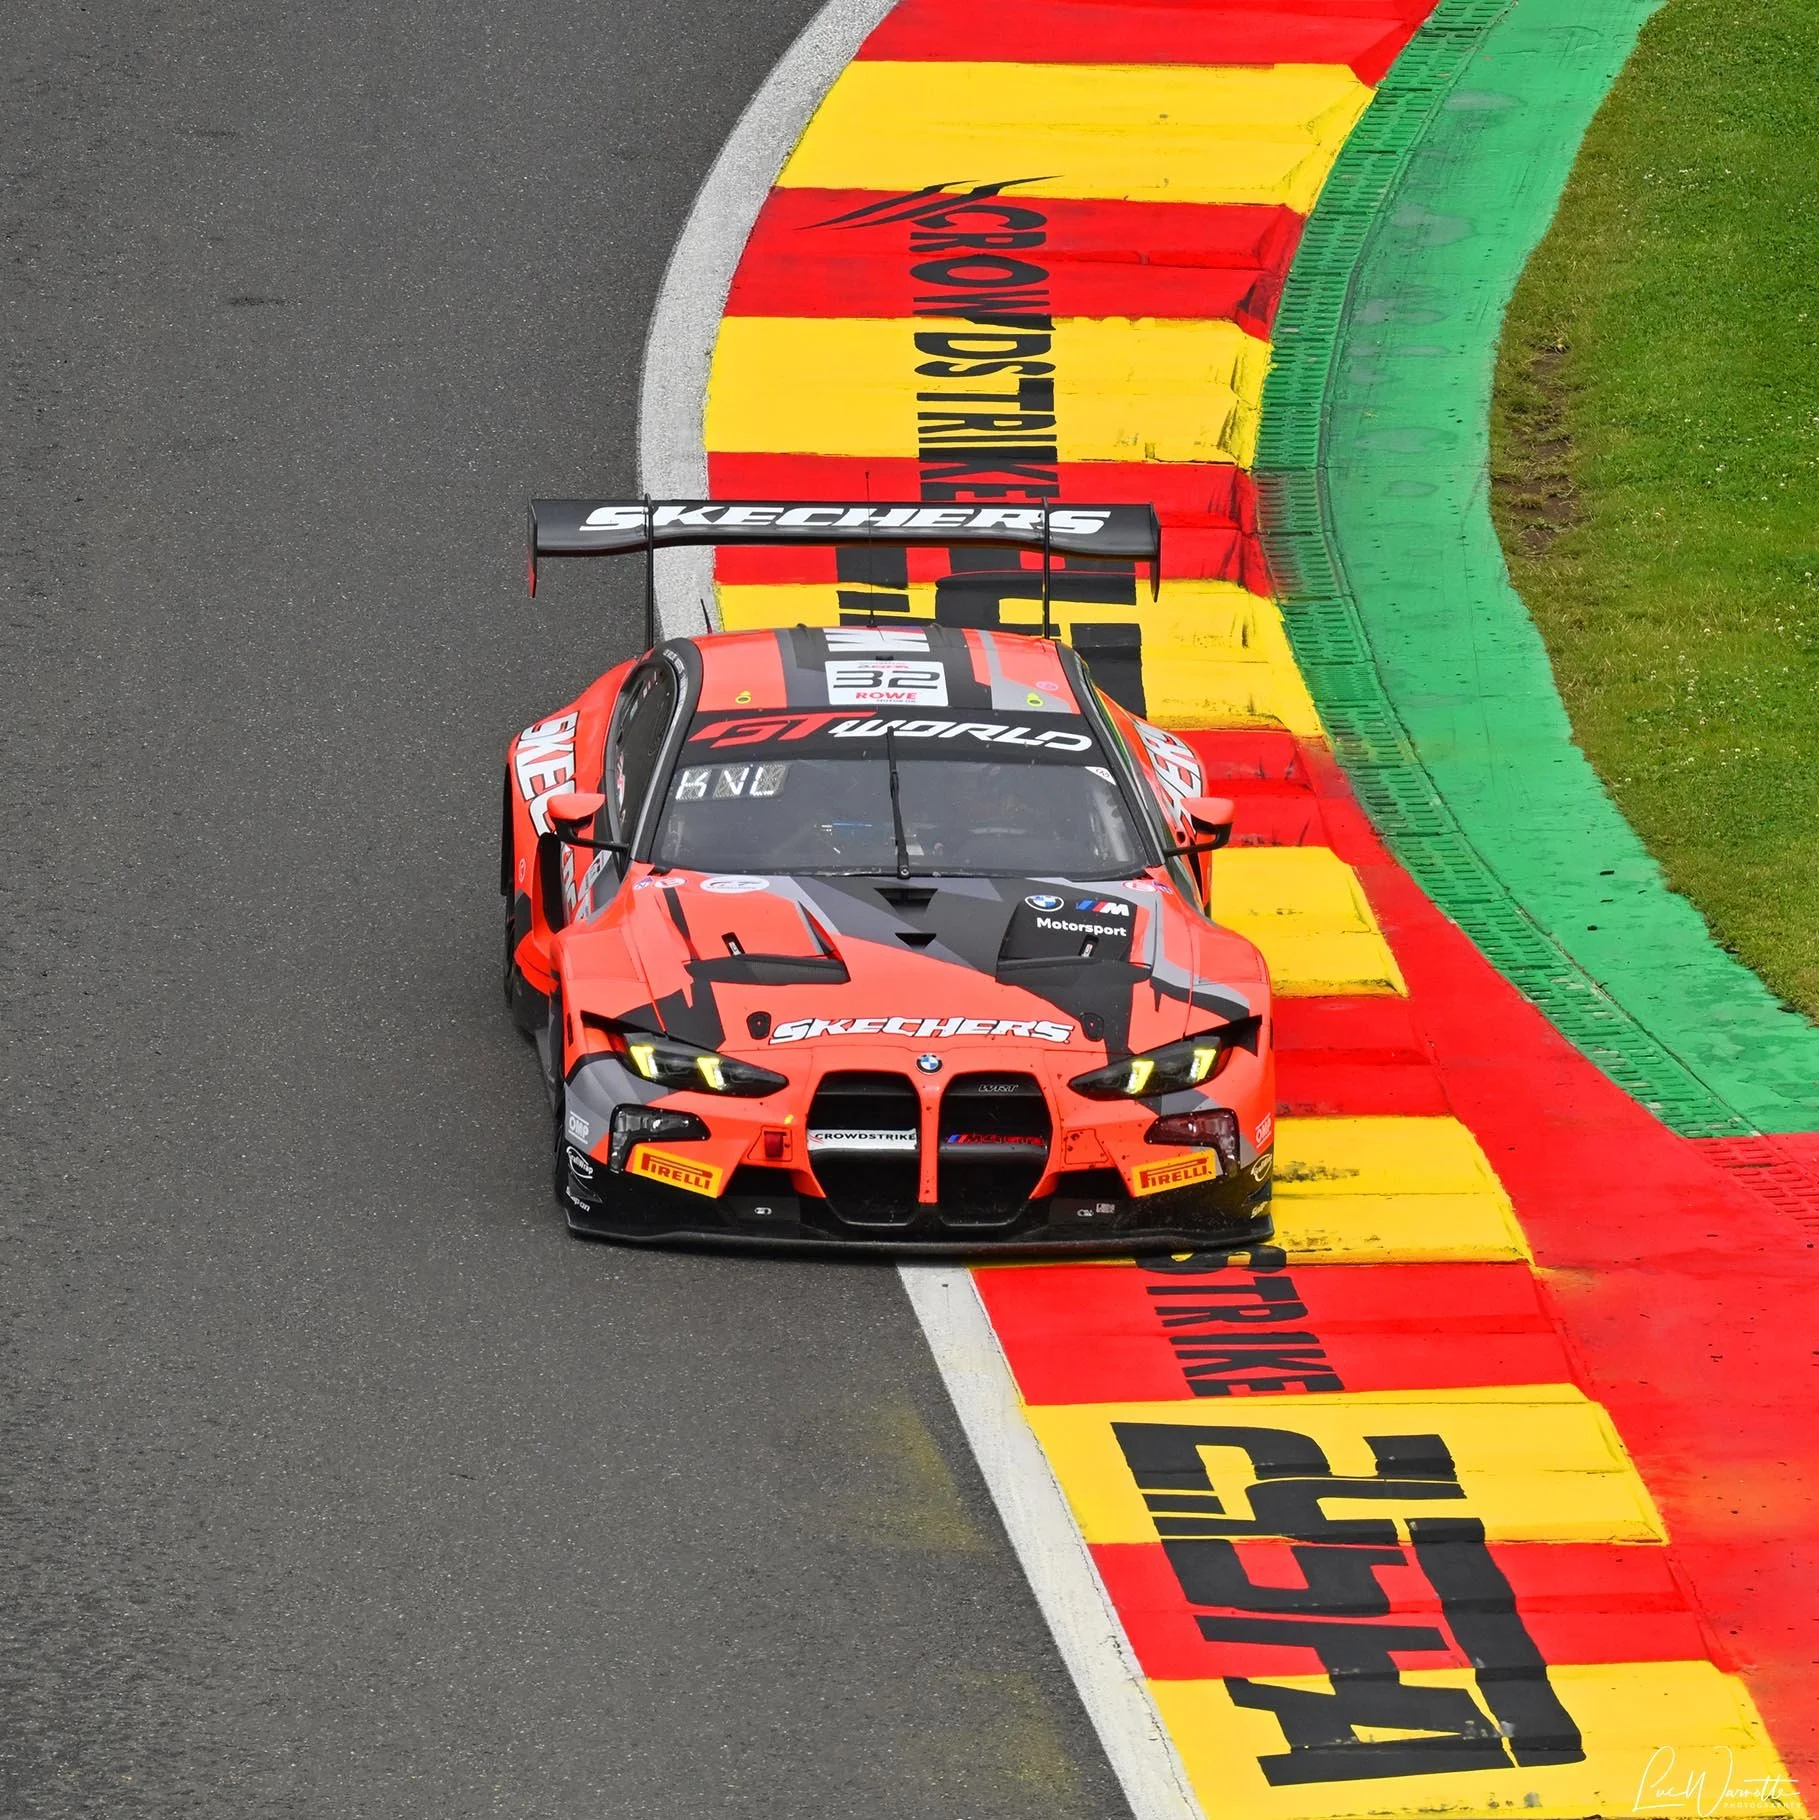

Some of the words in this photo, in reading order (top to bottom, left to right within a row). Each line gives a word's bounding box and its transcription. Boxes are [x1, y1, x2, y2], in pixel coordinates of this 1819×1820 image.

[909, 204, 1060, 501] CROWDSTRIKE
[579, 505, 1110, 534] SKECHERS
[833, 670, 940, 689] 32
[688, 711, 877, 749] GT
[828, 719, 1092, 752] WORLD
[1036, 917, 1127, 937] Motorsport
[769, 1016, 1071, 1045] SKECHERS
[978, 1084, 1018, 1093] WRT
[568, 1115, 589, 1139] OMP
[815, 1132, 917, 1142] CROWDSTRIKE
[641, 1153, 713, 1190] PIRELLI
[1139, 1157, 1208, 1189] PIRELLI
